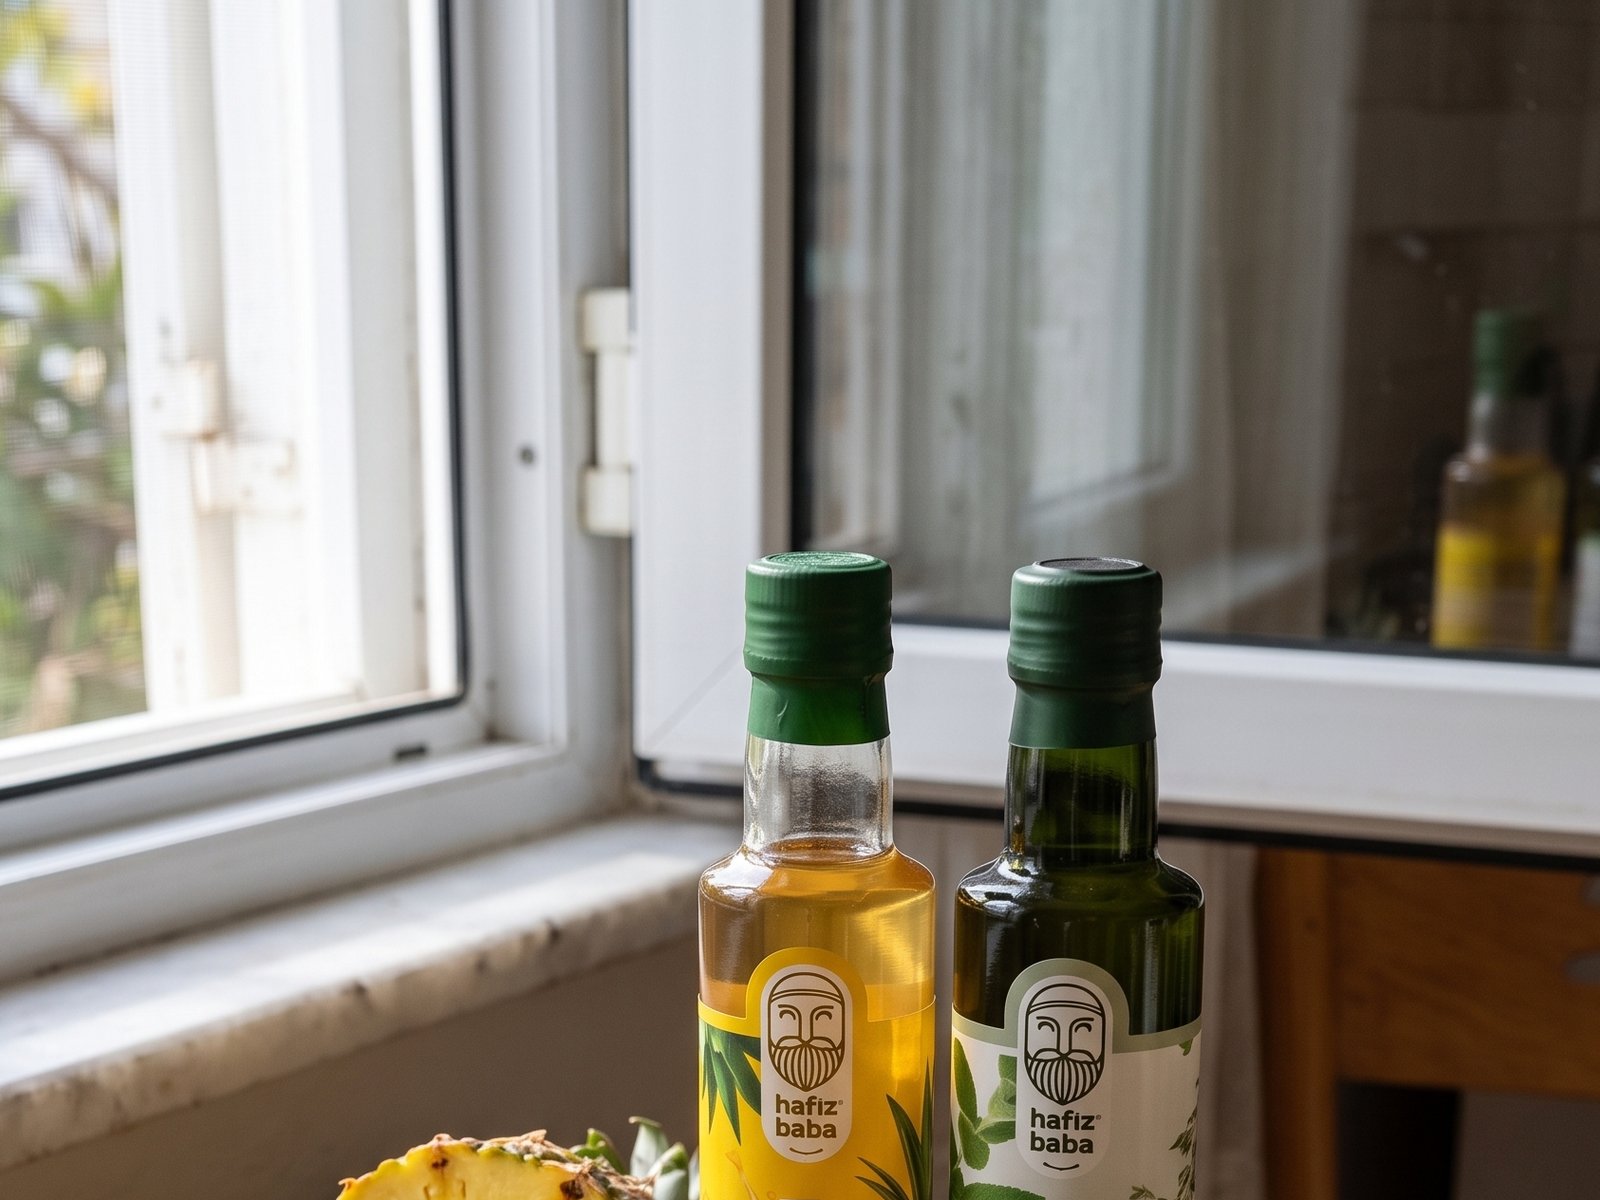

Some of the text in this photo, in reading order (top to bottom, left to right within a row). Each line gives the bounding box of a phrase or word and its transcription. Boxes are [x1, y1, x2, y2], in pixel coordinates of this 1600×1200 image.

[775, 1093, 838, 1116] hafiz
[775, 1118, 837, 1139] baba
[1030, 1107, 1095, 1131] hafiz
[1030, 1130, 1094, 1154] baba
